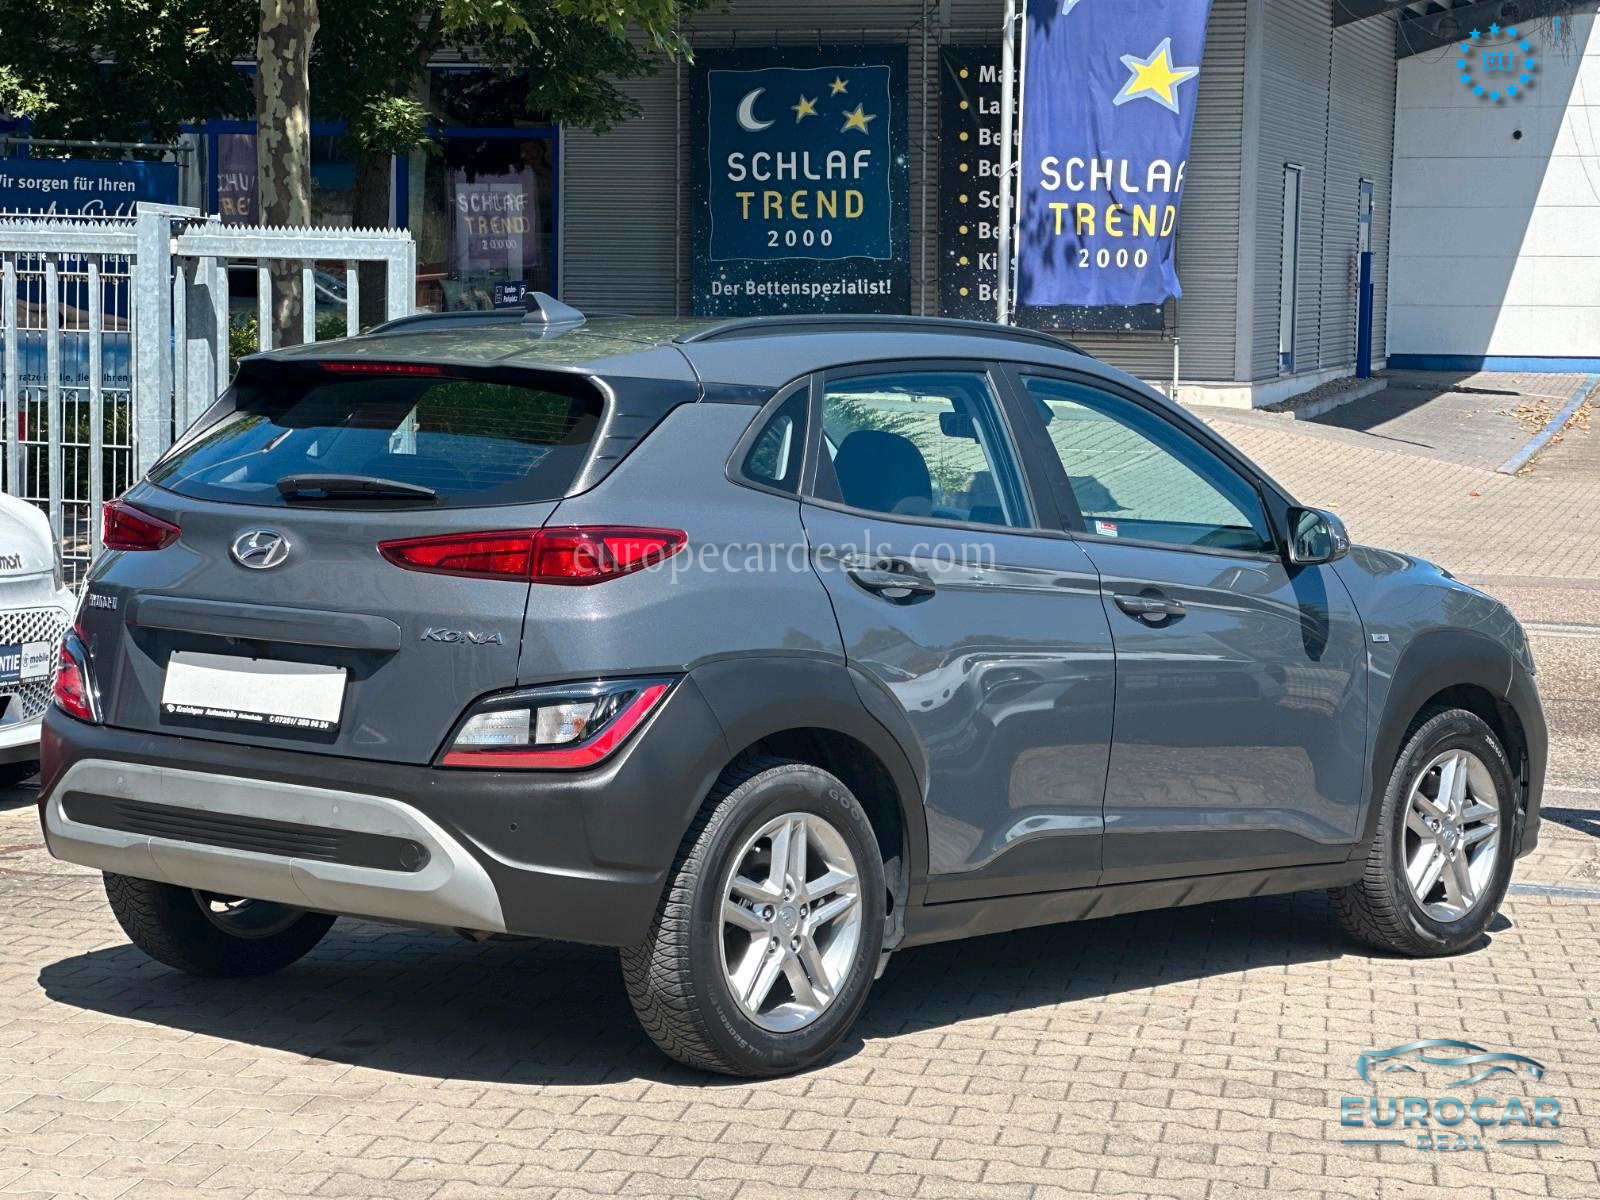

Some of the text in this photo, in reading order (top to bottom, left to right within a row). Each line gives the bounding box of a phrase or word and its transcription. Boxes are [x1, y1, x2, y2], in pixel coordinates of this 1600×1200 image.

[727, 150, 871, 181] SCHLAF
[18, 178, 69, 192] sorgen
[73, 176, 95, 191] für
[98, 178, 136, 192] Ihren
[736, 190, 864, 219] TREND
[464, 216, 530, 234] TREND
[1049, 203, 1176, 237] TREND
[767, 229, 833, 246] 2000
[1078, 248, 1148, 268] 2000
[711, 279, 892, 298] Der Bettenspezialist!
[421, 627, 504, 645] KONA
